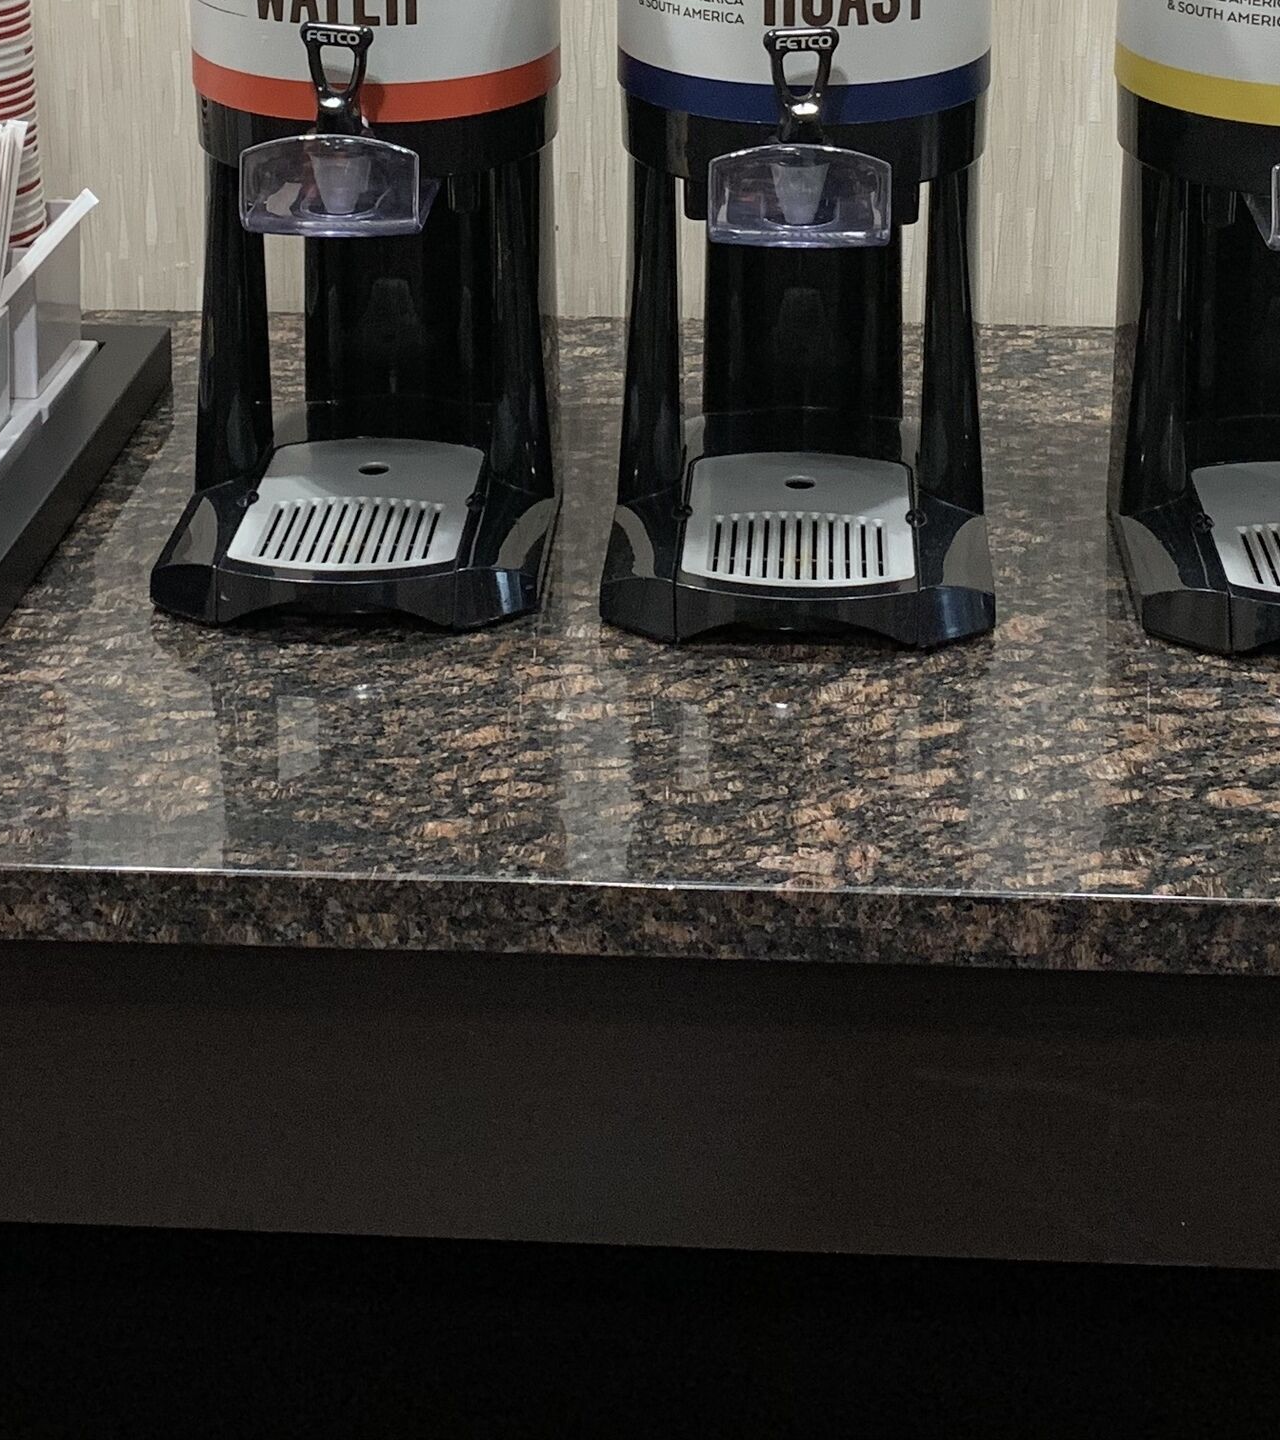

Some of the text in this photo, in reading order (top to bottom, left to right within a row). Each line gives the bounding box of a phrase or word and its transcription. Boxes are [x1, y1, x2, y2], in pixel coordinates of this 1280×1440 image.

[682, 6, 745, 26] AMERICA
[1177, 0, 1224, 22] SOUTH
[305, 29, 362, 46] FETCO
[774, 34, 834, 51] FETCO
